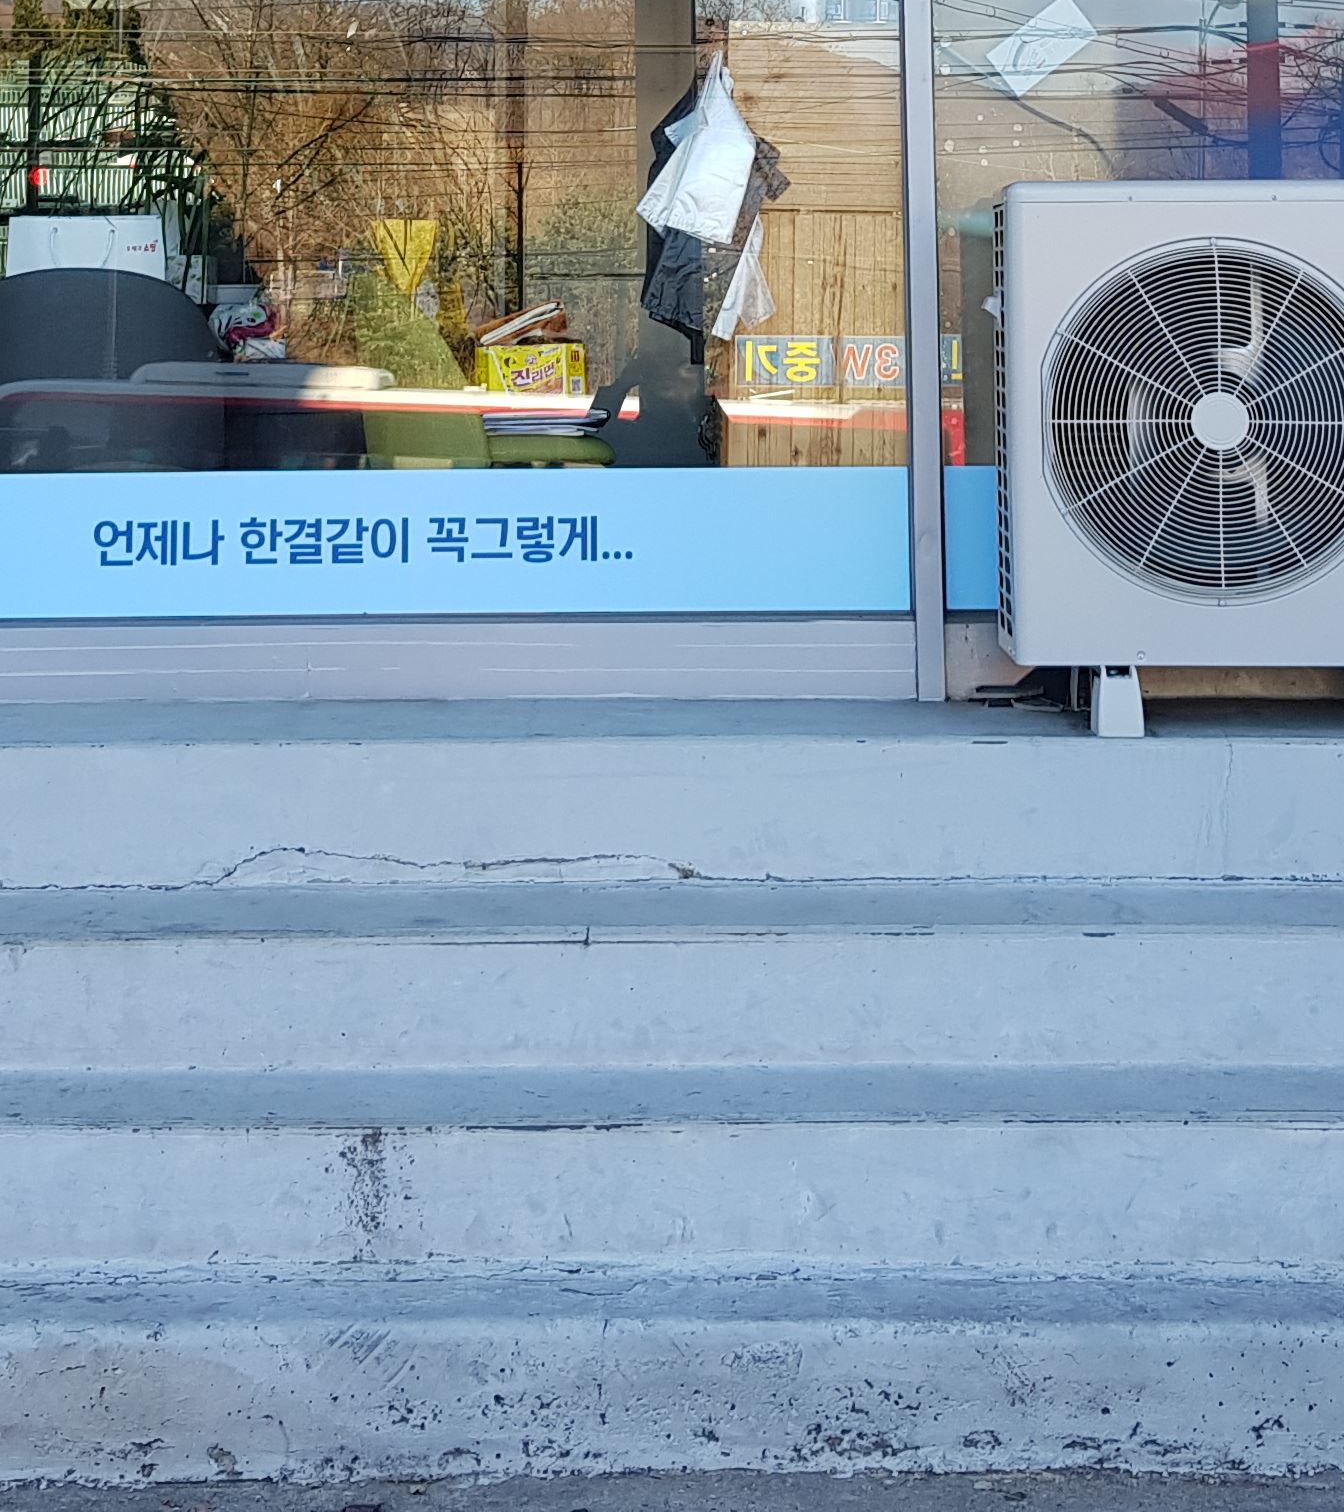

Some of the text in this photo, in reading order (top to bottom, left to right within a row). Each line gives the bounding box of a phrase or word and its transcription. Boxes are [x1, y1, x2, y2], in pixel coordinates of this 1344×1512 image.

[92, 515, 634, 567] 언제나 한결같이 꼭그렇게...
